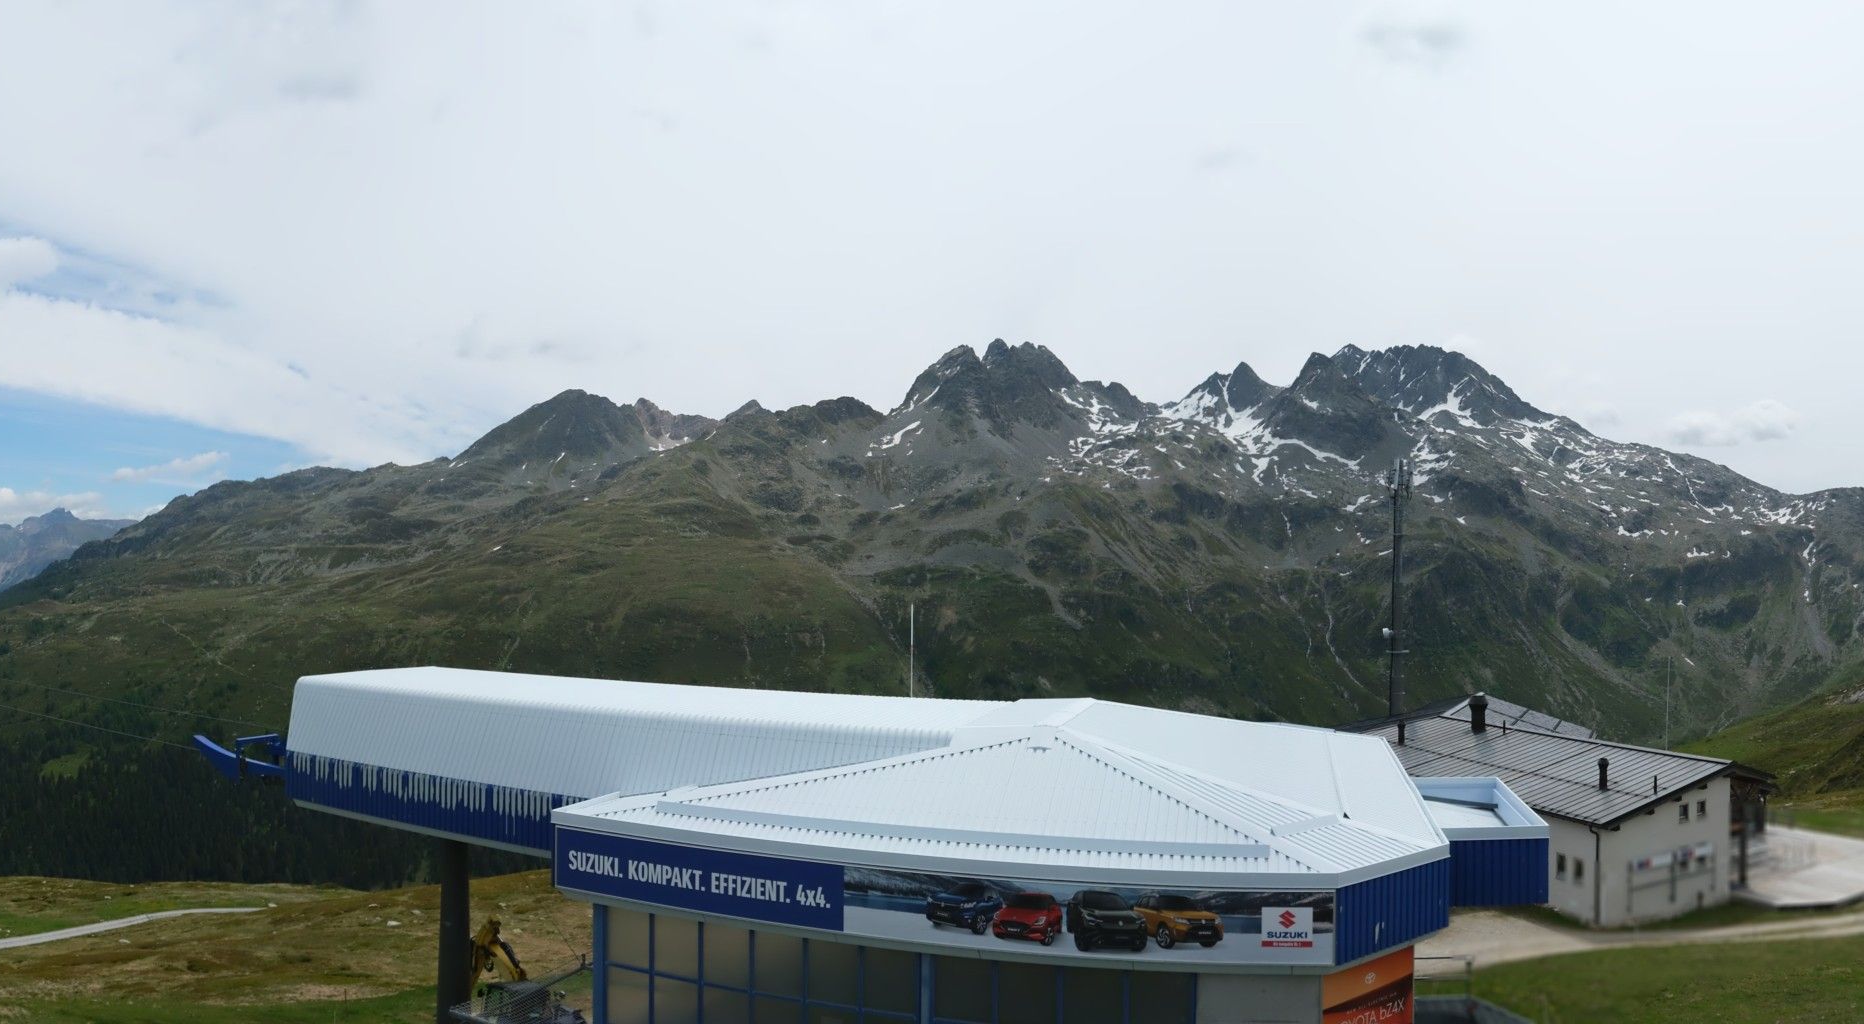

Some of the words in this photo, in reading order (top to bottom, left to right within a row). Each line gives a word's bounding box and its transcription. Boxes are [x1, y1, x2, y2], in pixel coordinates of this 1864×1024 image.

[568, 850, 623, 878] SUZUKI.
[628, 860, 705, 891] KOMPAKT.
[711, 872, 791, 903] EFFIZIENT.
[796, 883, 831, 908] 4x4.
[1267, 931, 1308, 939] SUZUKI
[1379, 997, 1405, 1020] bZ4X
